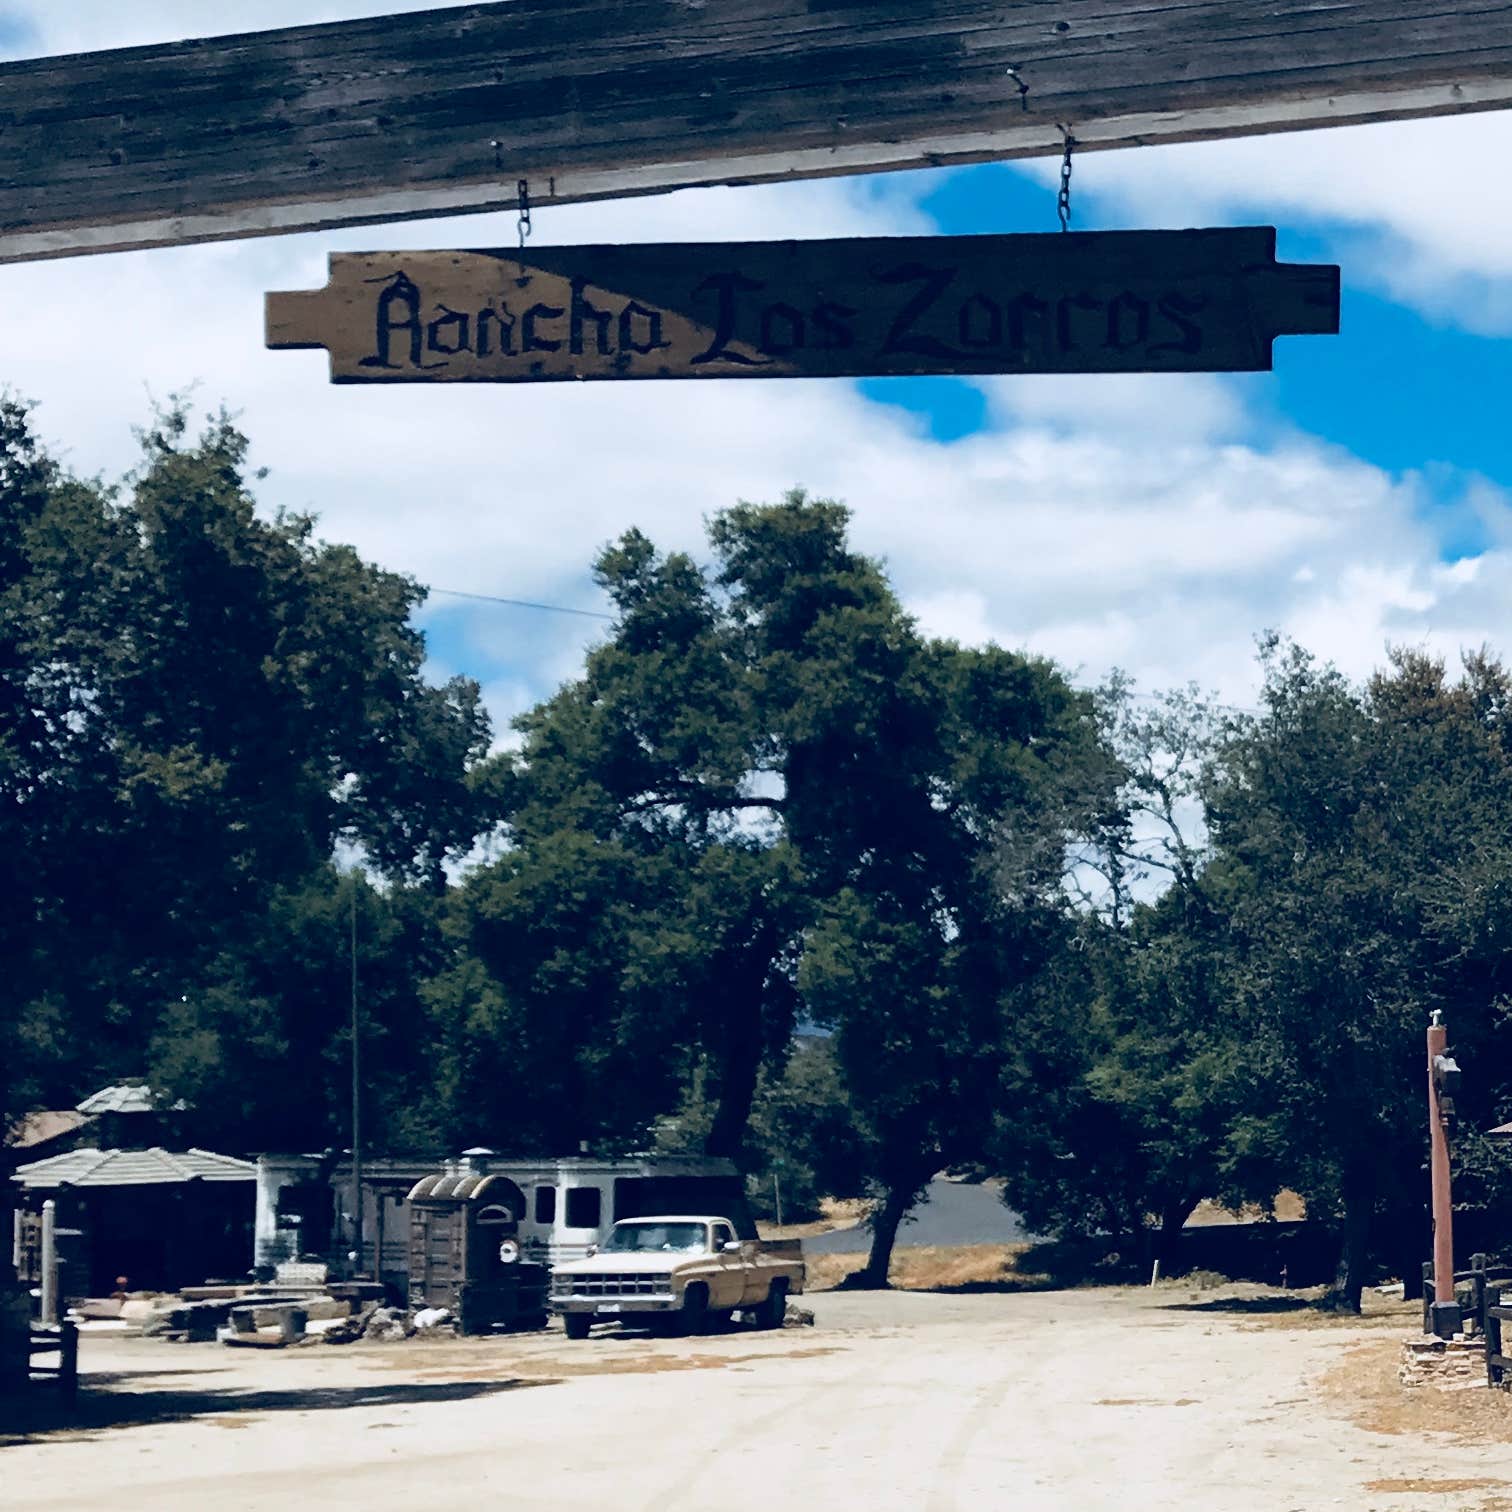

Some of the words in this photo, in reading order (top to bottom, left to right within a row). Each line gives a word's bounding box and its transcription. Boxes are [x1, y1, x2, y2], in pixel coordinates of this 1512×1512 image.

[358, 270, 672, 369] Rancho
[690, 270, 856, 364] Los
[866, 262, 1209, 361] Zorros
